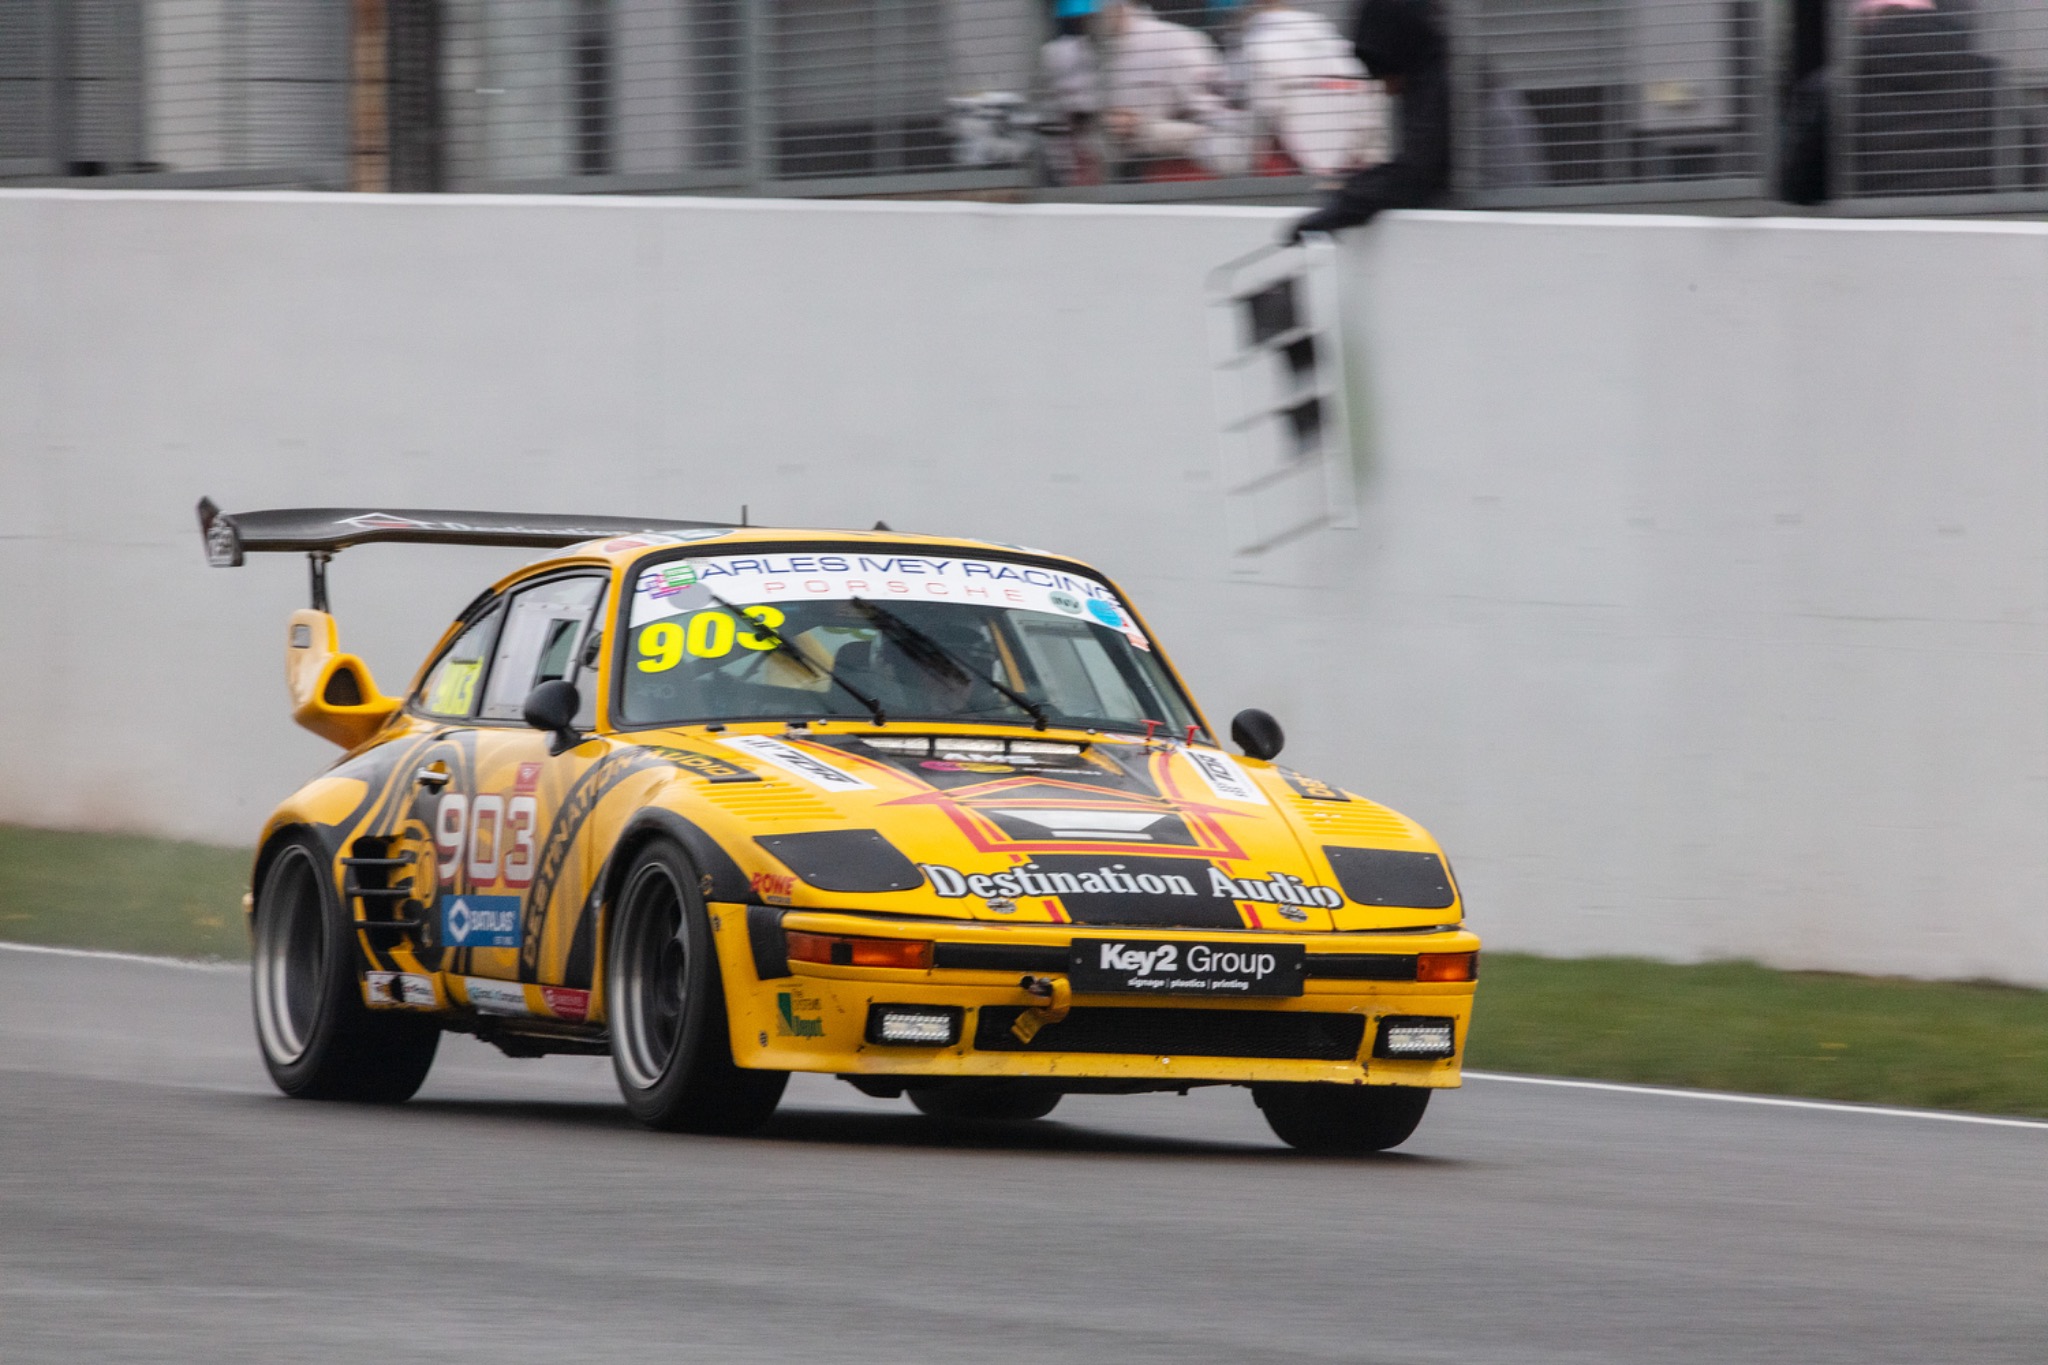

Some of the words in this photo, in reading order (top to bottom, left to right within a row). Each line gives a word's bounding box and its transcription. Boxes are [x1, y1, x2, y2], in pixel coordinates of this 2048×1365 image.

[634, 556, 849, 593] CARLES
[862, 556, 950, 576] IVEY
[764, 579, 1025, 602] PORSCHE
[636, 605, 785, 673] 903
[436, 792, 538, 887] 903
[923, 862, 1198, 898] Destination
[1211, 865, 1343, 909] Audio
[1099, 943, 1178, 976] Key2
[1187, 944, 1276, 980] Group
[1127, 977, 1165, 988] signage
[1170, 977, 1206, 989] plastics
[1211, 978, 1249, 990] printing
